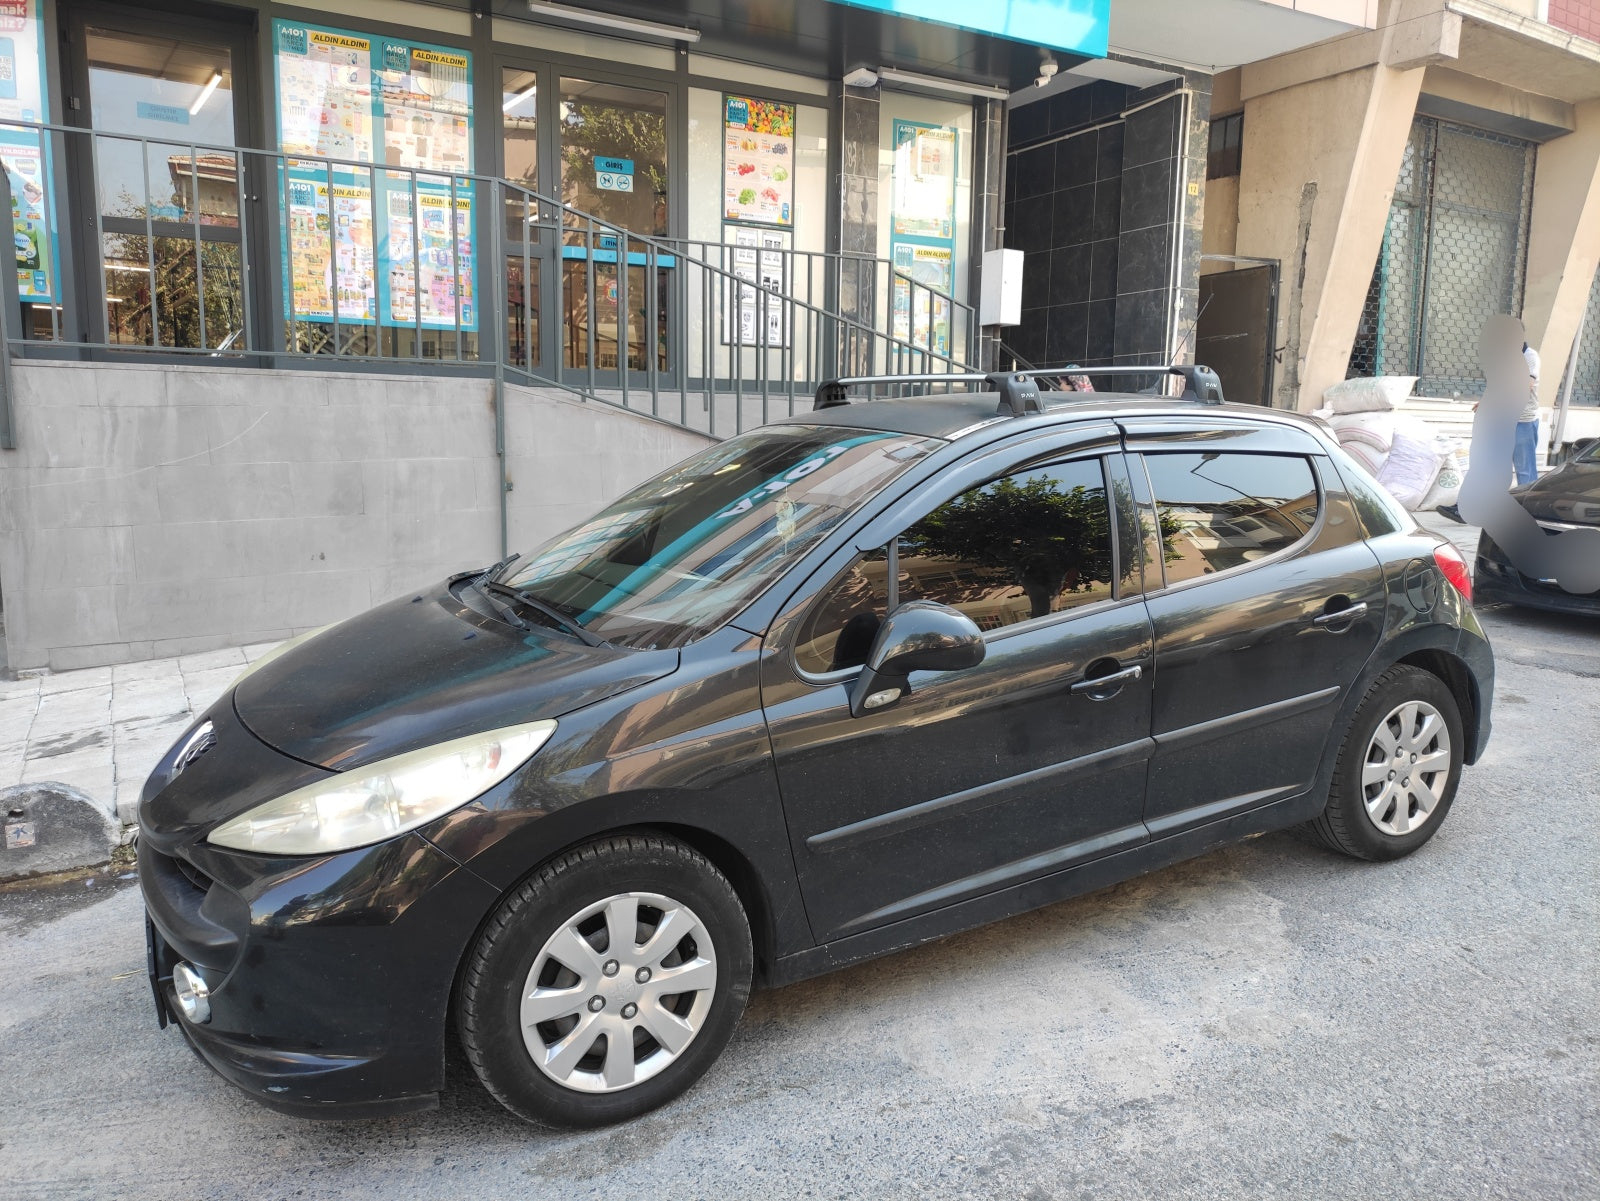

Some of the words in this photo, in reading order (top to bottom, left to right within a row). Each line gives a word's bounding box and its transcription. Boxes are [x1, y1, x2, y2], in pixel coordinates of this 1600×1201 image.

[313, 34, 339, 45] ALDIN
[340, 38, 368, 49] ALDIN!
[415, 52, 440, 62] ALDIN
[440, 55, 466, 66] ALDIN!
[605, 161, 623, 171] GİRİŞ
